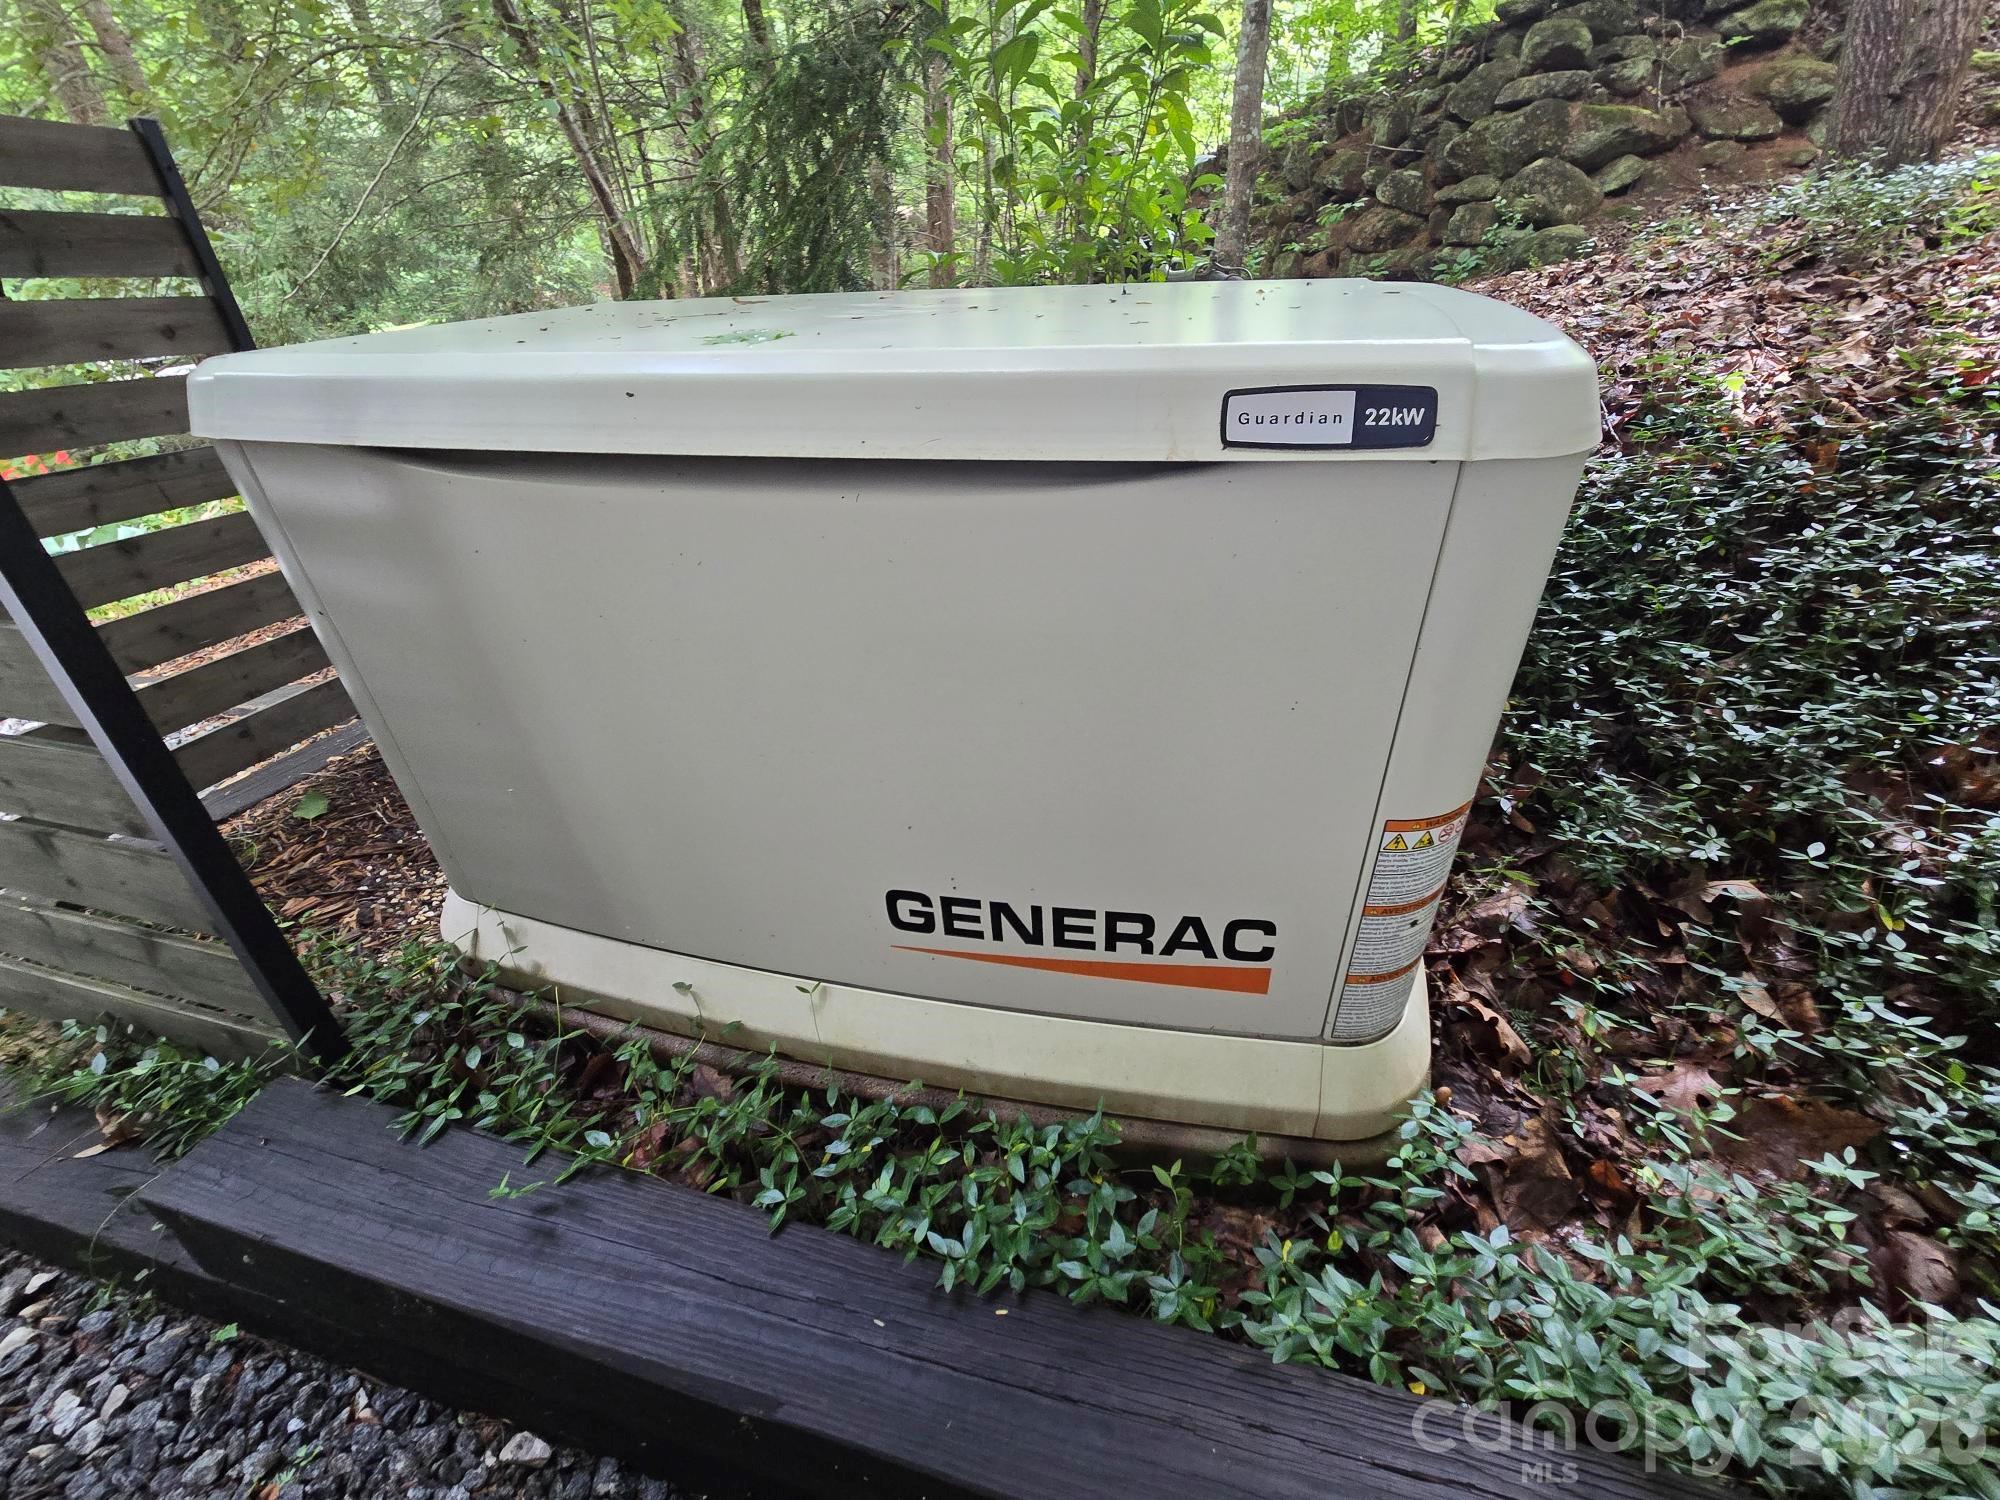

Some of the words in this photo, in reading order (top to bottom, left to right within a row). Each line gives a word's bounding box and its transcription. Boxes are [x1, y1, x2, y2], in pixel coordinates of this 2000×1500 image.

[1238, 411, 1343, 425] Guardian
[1365, 407, 1425, 426] 22kW
[885, 889, 1277, 962] GENERAC
